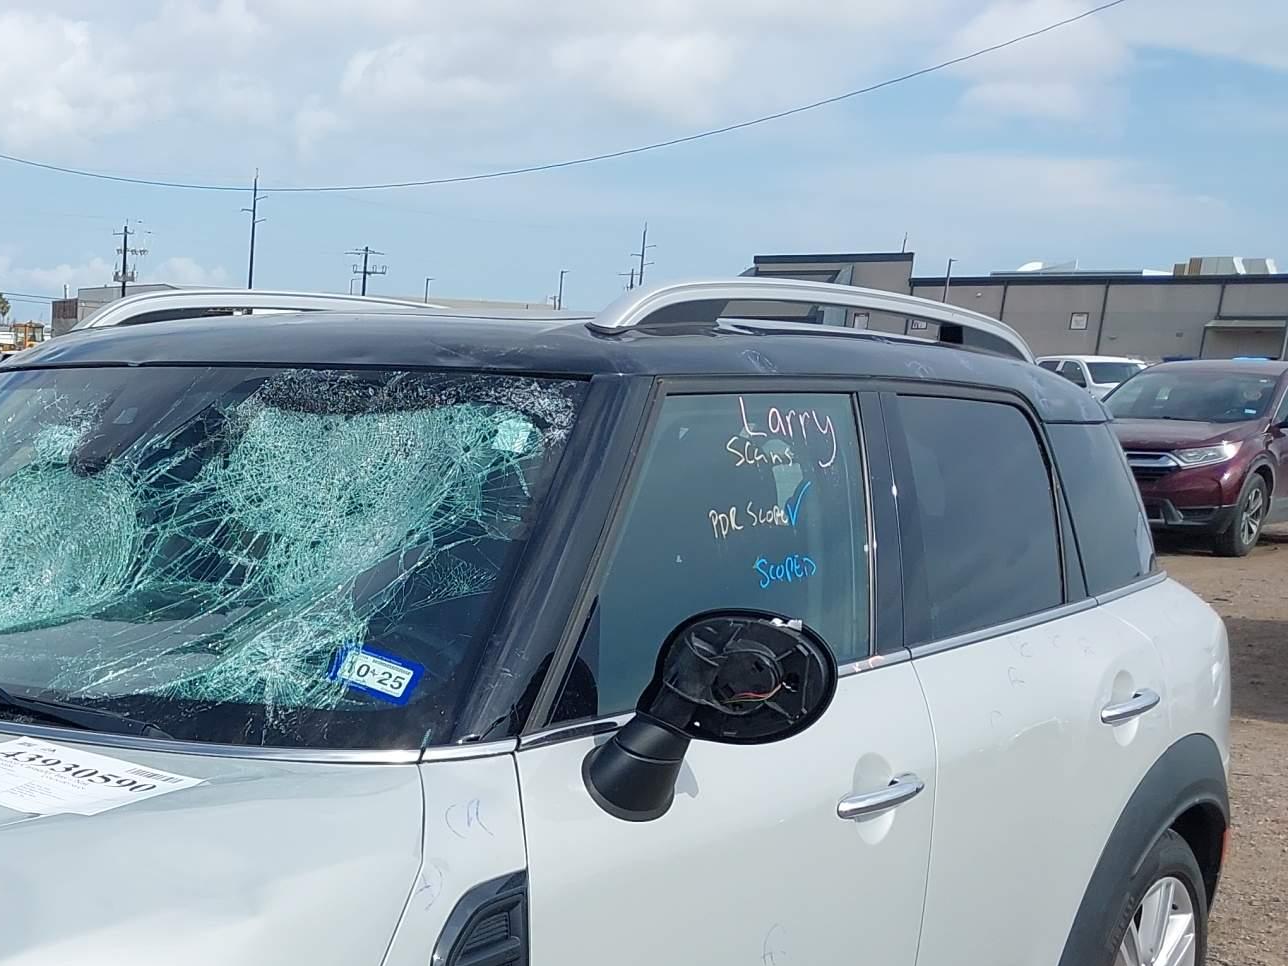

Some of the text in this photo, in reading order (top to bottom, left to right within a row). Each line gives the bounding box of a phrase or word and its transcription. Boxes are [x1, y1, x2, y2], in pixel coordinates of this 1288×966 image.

[738, 396, 838, 468] Larry
[708, 506, 744, 539] PDR
[0, 750, 157, 793] 43930590
